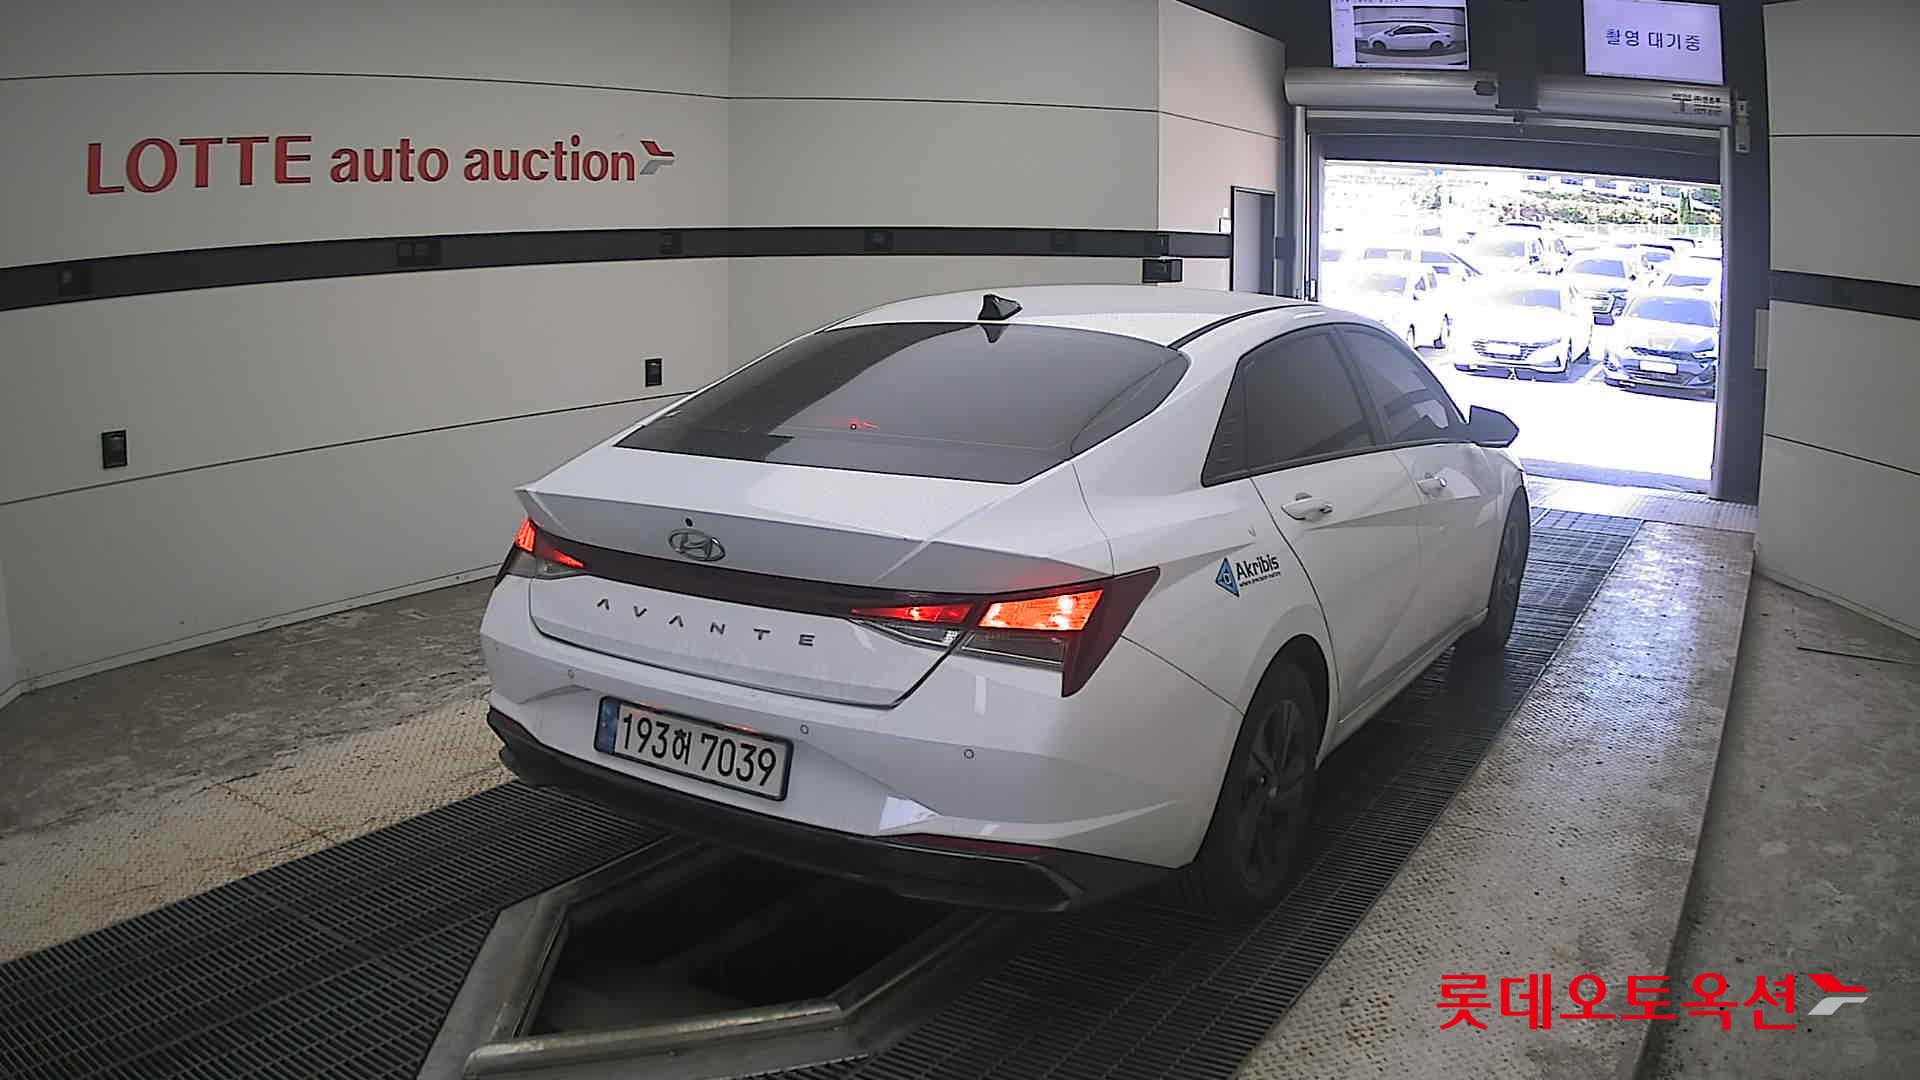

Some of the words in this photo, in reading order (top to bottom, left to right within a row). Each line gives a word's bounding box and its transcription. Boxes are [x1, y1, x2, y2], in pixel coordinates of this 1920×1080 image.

[1606, 28, 1640, 47] 촬영
[1648, 31, 1701, 52] 대기중
[86, 135, 312, 195] LOTTE
[329, 138, 449, 183] auto
[463, 134, 636, 183] auction
[1235, 553, 1280, 581] Akribis
[596, 598, 817, 648] AVANTE
[623, 713, 693, 766] 193허
[700, 732, 777, 787] 7039
